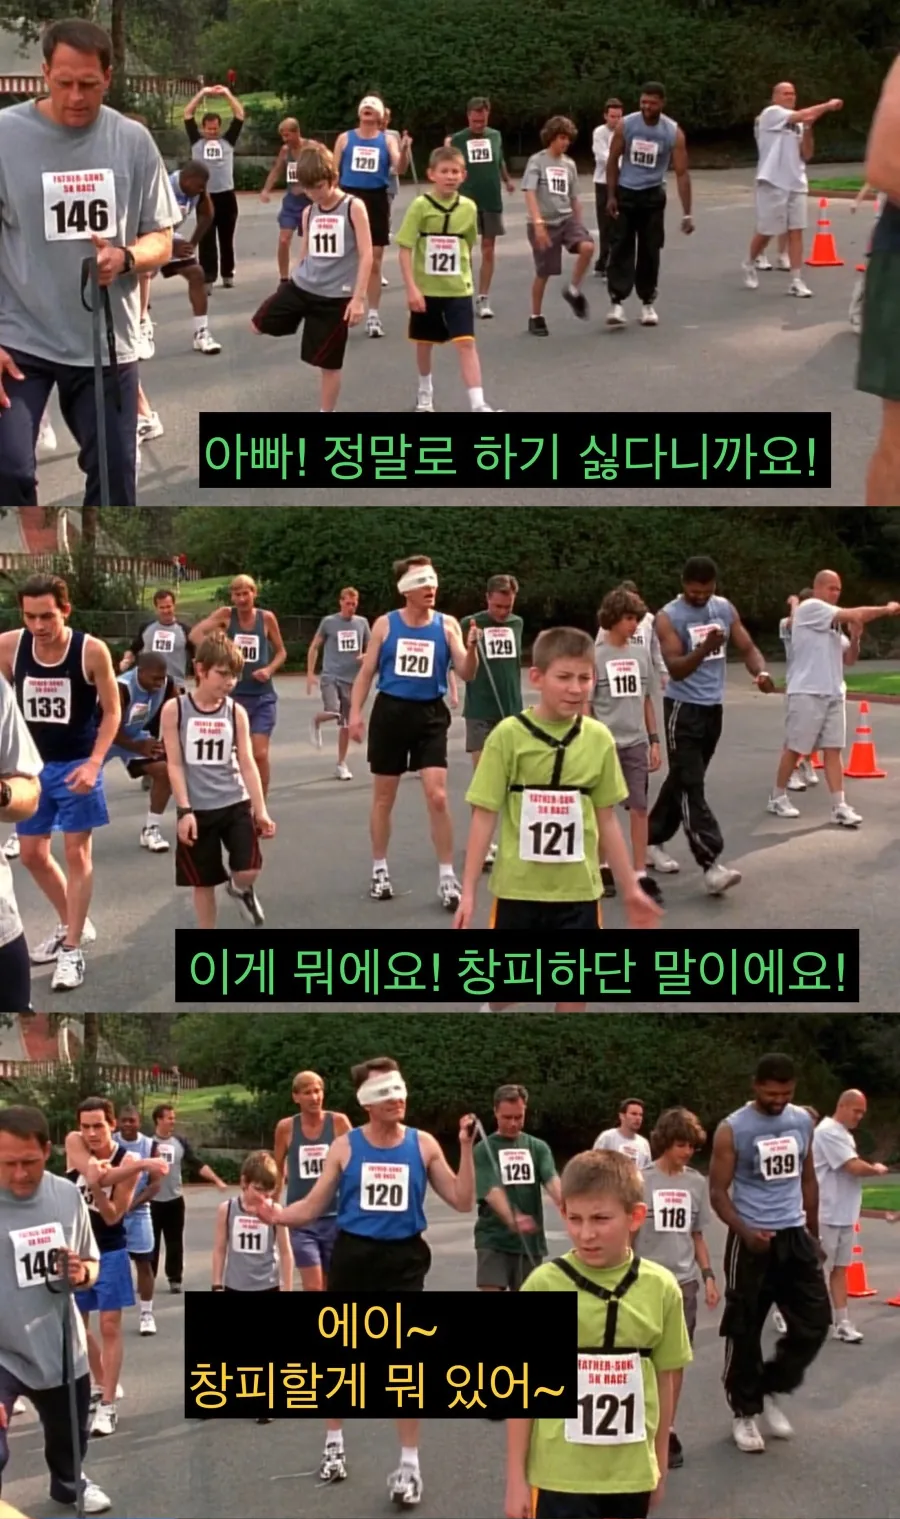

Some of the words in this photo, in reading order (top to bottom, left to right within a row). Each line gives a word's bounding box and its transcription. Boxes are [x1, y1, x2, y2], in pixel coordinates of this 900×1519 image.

[355, 157, 376, 169] 120
[51, 199, 109, 234] 146
[312, 233, 338, 254] 111
[430, 253, 456, 272] 121
[488, 639, 513, 655] 129
[399, 654, 430, 673] 120
[613, 674, 637, 693] 118
[28, 697, 66, 719] 133
[194, 739, 224, 761] 111
[528, 821, 576, 856] 121
[504, 1163, 531, 1181] 129
[763, 1153, 795, 1177] 139
[365, 1183, 404, 1206] 120
[659, 1207, 686, 1228] 118
[238, 1232, 261, 1250] 111
[577, 1393, 635, 1436] 121
